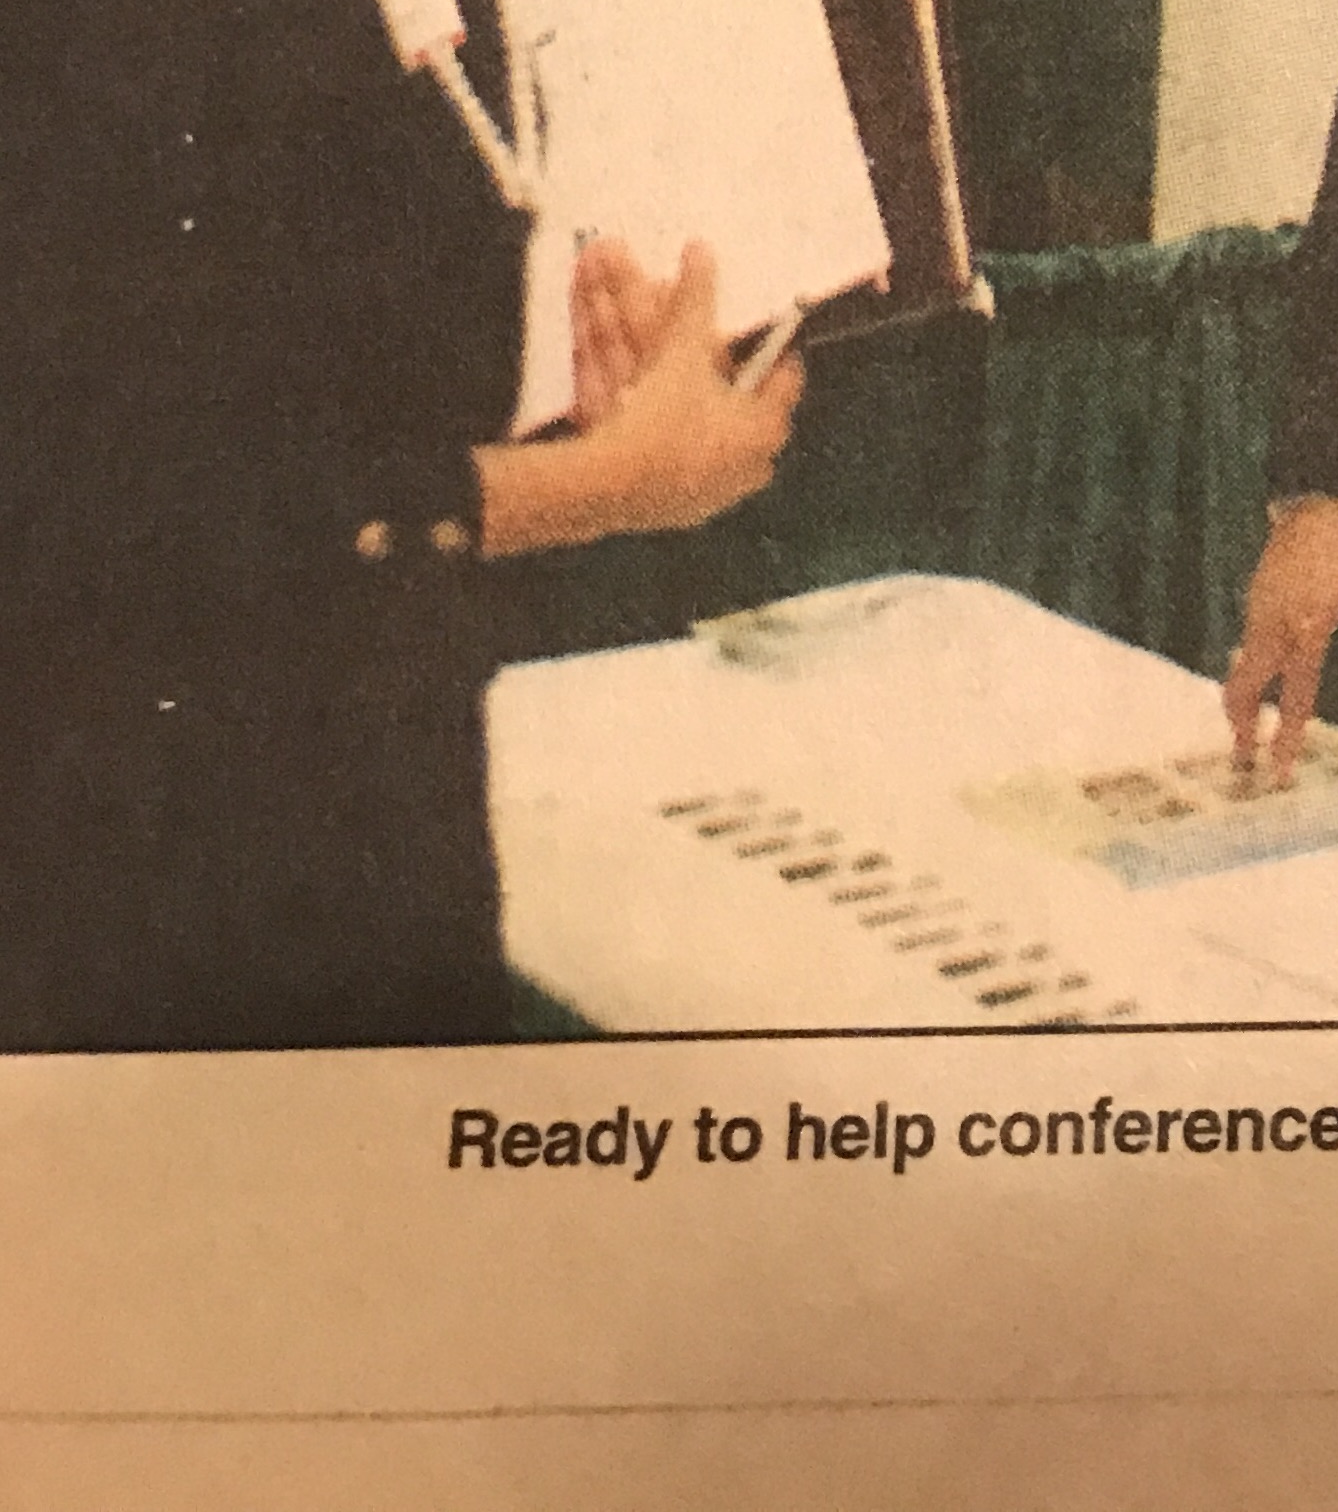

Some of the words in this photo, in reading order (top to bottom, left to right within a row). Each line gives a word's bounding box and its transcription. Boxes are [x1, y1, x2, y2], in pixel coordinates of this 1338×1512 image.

[447, 1104, 673, 1181] Ready
[692, 1106, 764, 1164] to
[785, 1100, 936, 1176] help
